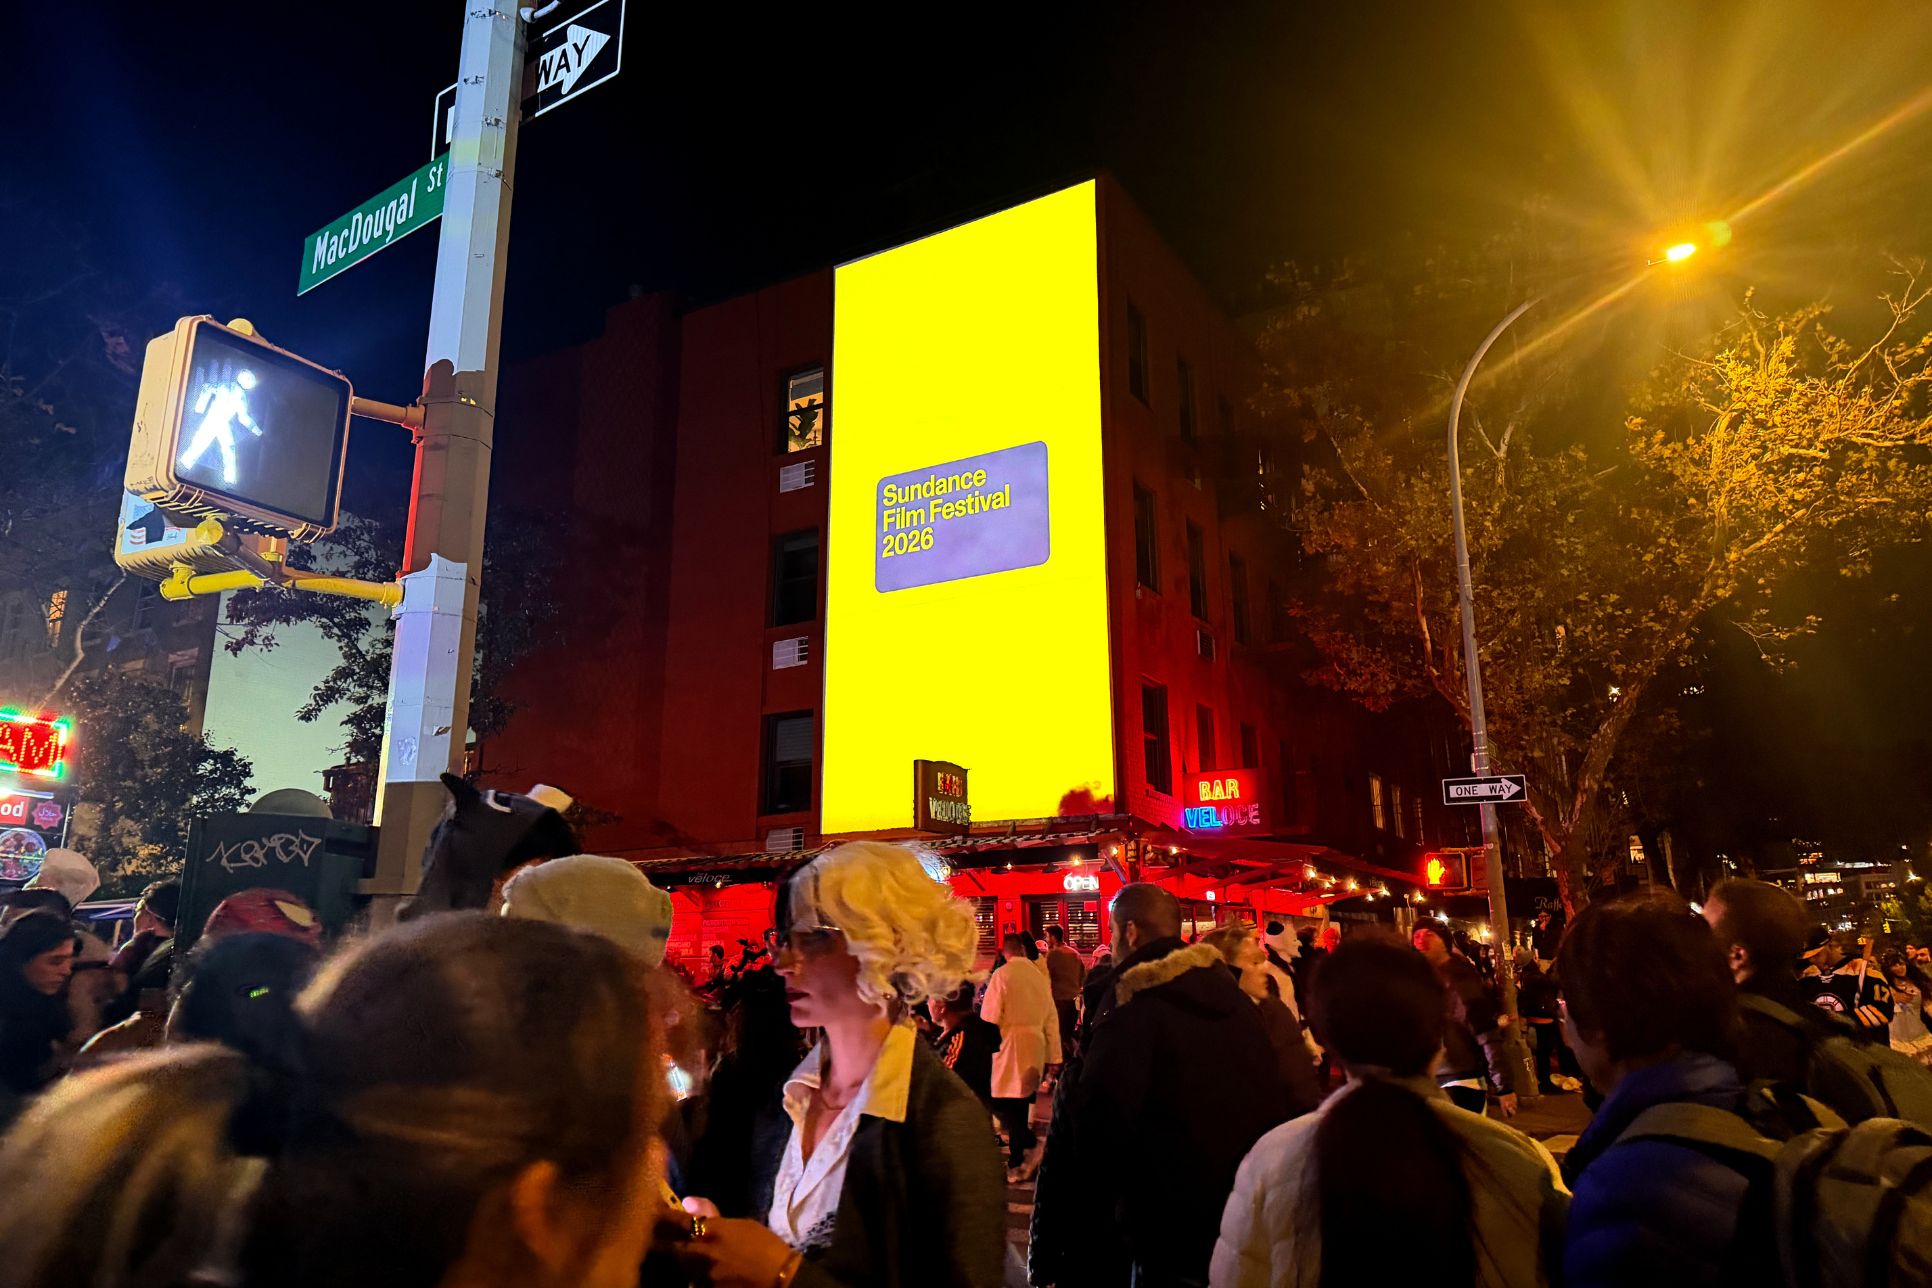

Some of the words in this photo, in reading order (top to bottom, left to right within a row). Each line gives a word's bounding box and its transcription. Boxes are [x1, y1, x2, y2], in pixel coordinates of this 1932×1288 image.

[311, 176, 418, 275] MacDougal
[426, 161, 444, 193] St
[882, 468, 987, 507] Sundance
[882, 507, 926, 533] Film
[929, 483, 1011, 523] Festival
[881, 526, 935, 559] 2026
[1199, 778, 1240, 801] BAR
[1455, 785, 1479, 796] ONE
[1488, 783, 1513, 796] WAY
[1184, 803, 1261, 829] VELOCE
[1874, 984, 1891, 1004] 17
